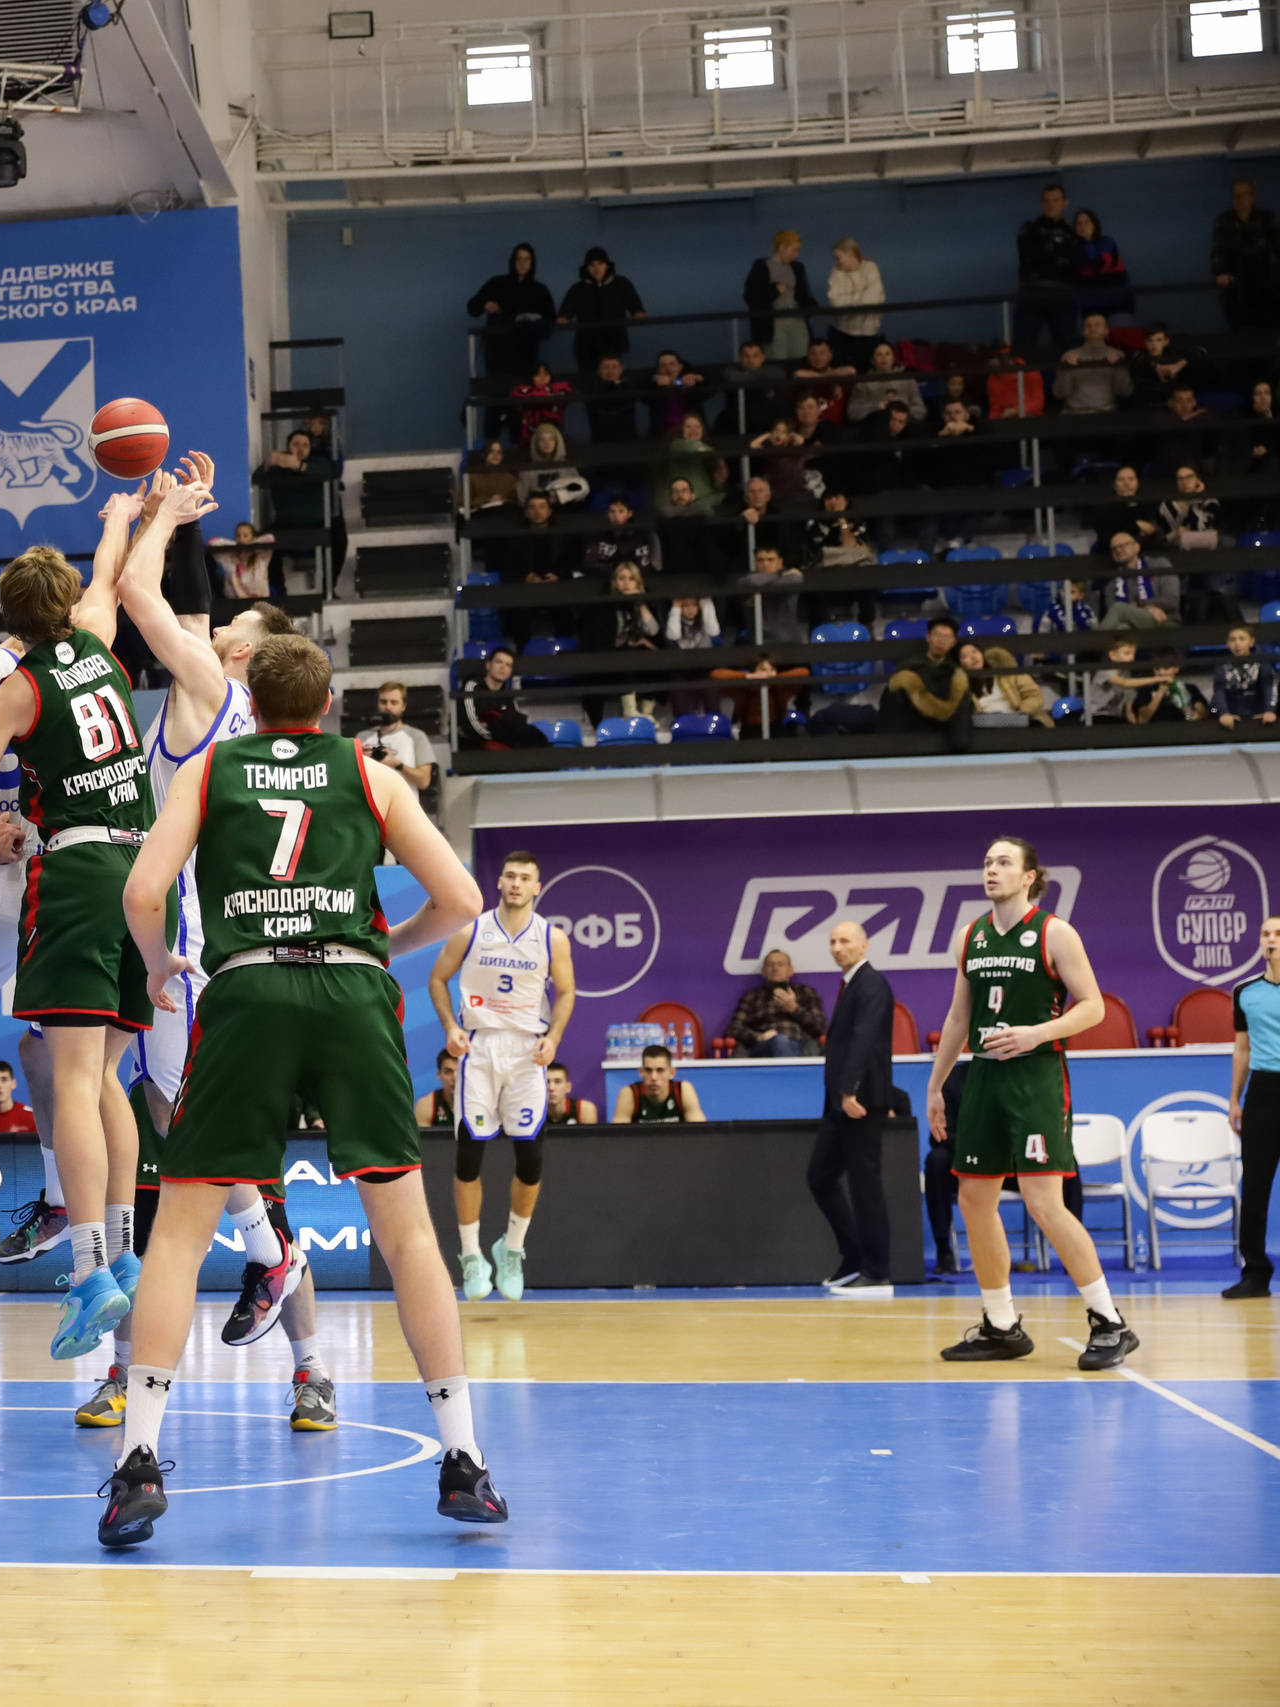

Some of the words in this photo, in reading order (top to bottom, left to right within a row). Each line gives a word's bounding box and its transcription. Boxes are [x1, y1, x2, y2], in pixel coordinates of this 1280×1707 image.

[74, 297, 137, 315] КРАЯ
[70, 684, 139, 763] 81
[62, 755, 147, 797] КРАСНОДАРС
[243, 763, 328, 790] ТЕМИРОВ
[257, 799, 313, 881] 7
[224, 886, 355, 919] КРАСНОДАРСКИЙ
[263, 913, 312, 938] КРАЙ
[1176, 911, 1247, 945] СУПЕР
[479, 956, 538, 971] ДИНАМО
[966, 956, 1036, 973] ЛОКОМОТИВ
[1192, 944, 1232, 968] ЛИГА
[497, 974, 514, 993] 3
[979, 970, 1012, 978] КУБАНЬ
[518, 1108, 533, 1127] 3
[1025, 1133, 1050, 1164] 4
